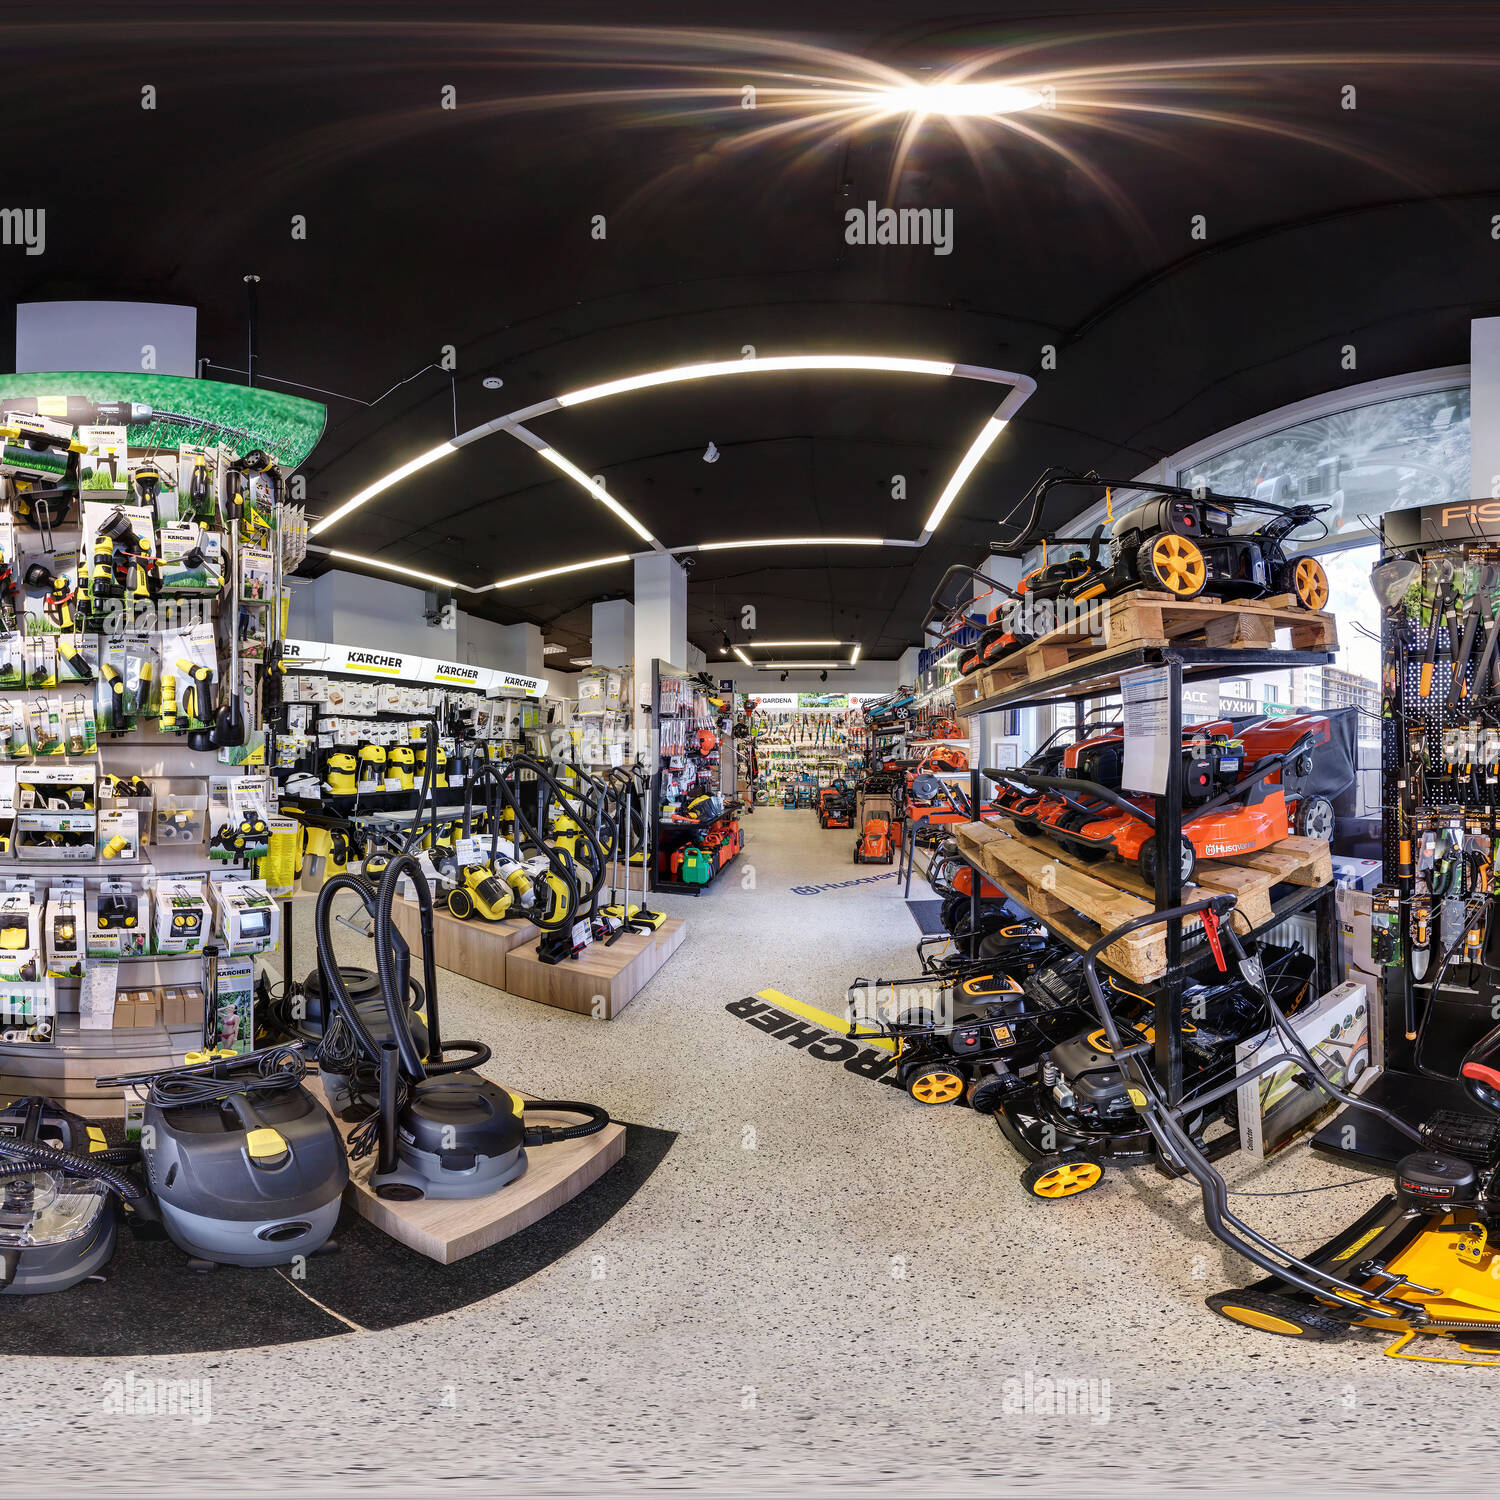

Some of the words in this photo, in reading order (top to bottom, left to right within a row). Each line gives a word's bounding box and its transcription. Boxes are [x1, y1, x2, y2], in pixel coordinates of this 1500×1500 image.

[347, 651, 402, 669] KÄRCHER
[436, 664, 478, 679] KÄRCHER
[505, 676, 537, 689] KÄRCHER
[1219, 699, 1255, 713] КУХНИ
